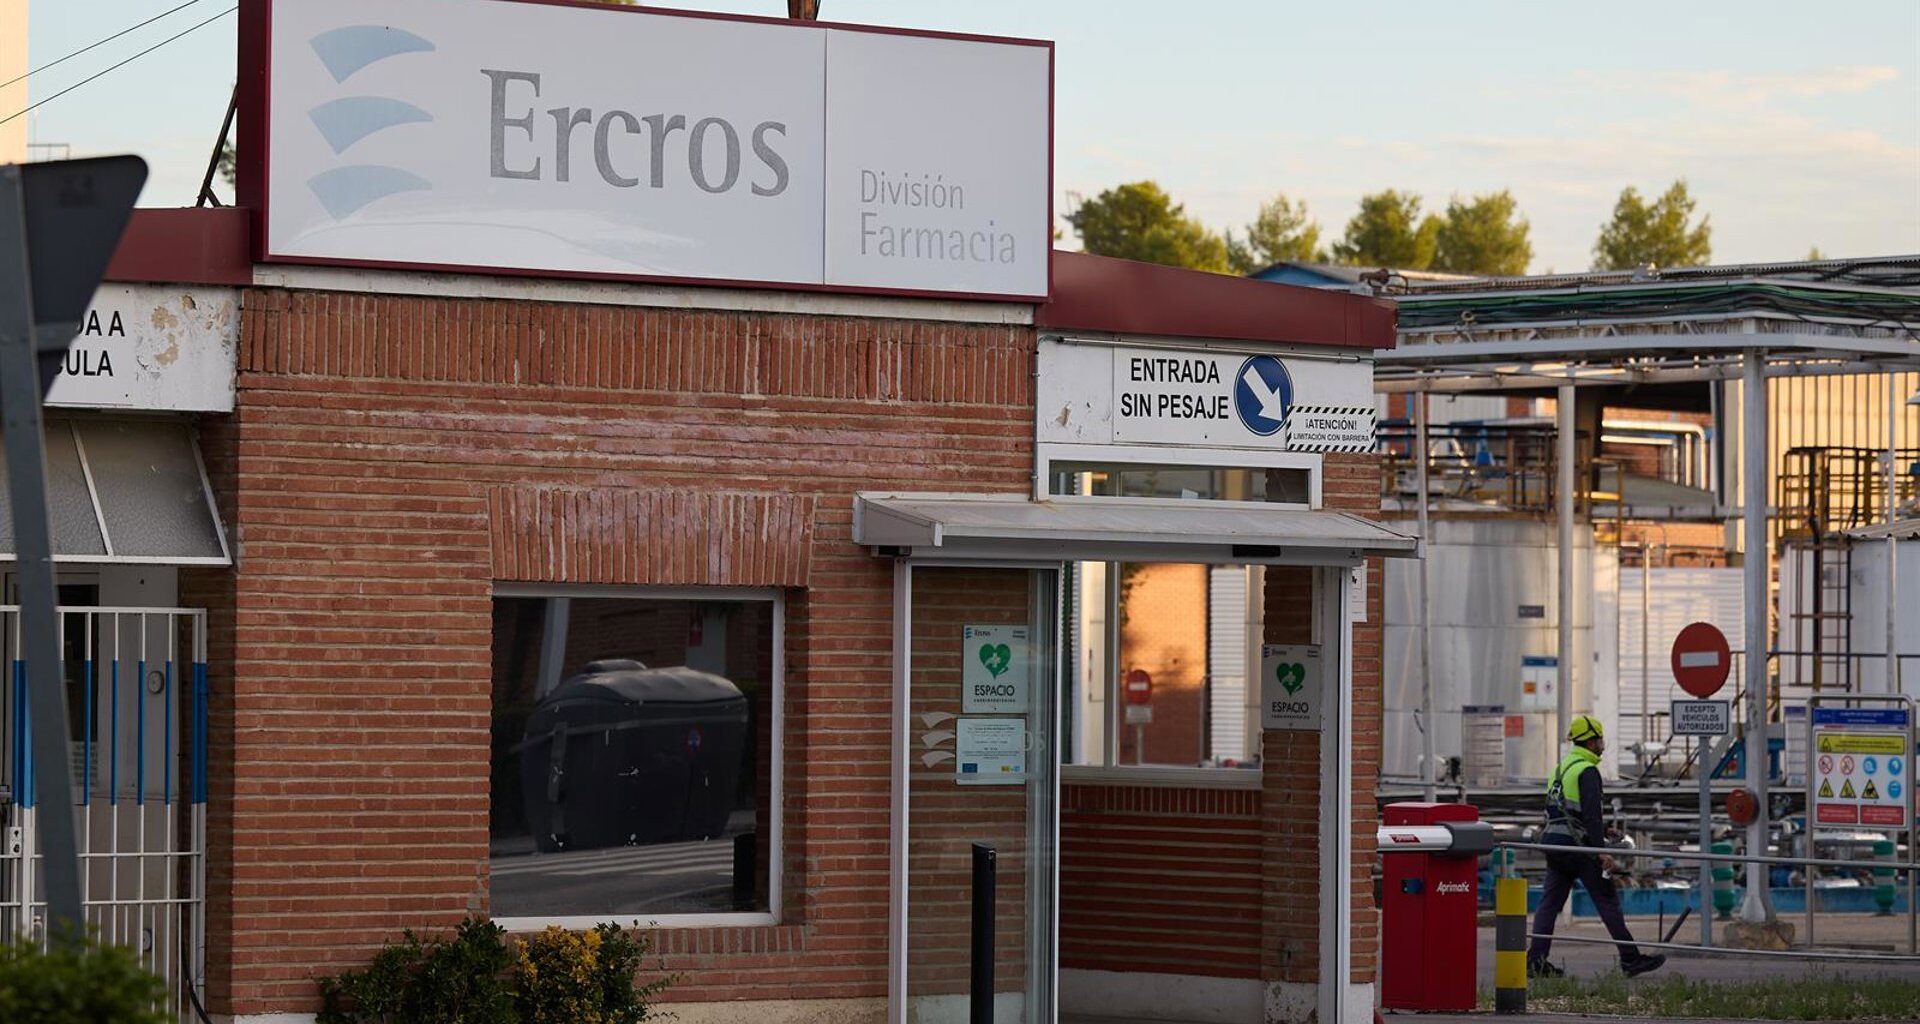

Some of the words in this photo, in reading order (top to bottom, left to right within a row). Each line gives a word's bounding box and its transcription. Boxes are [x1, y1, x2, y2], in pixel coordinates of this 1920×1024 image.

[480, 69, 789, 197] Ercros
[861, 169, 964, 209] División
[861, 212, 1016, 264] Farmacia
[107, 310, 126, 337] A
[57, 348, 114, 377] ULA
[1130, 358, 1220, 383] ENTRADA
[1121, 393, 1152, 418] SIN
[1158, 394, 1229, 420] PESAJE
[1305, 417, 1357, 430] ¡ATENCIÓN!
[1293, 432, 1326, 441] LIMITACIÓN
[1327, 434, 1341, 442] CON
[1342, 434, 1370, 442] BARRERA
[974, 684, 1015, 697] ESPACIO
[1271, 701, 1310, 714] ESPACIO
[1684, 705, 1716, 713] EXCEPTO
[1677, 722, 1725, 731] AUTORIZADOS
[1436, 881, 1470, 896] Aprimatic
